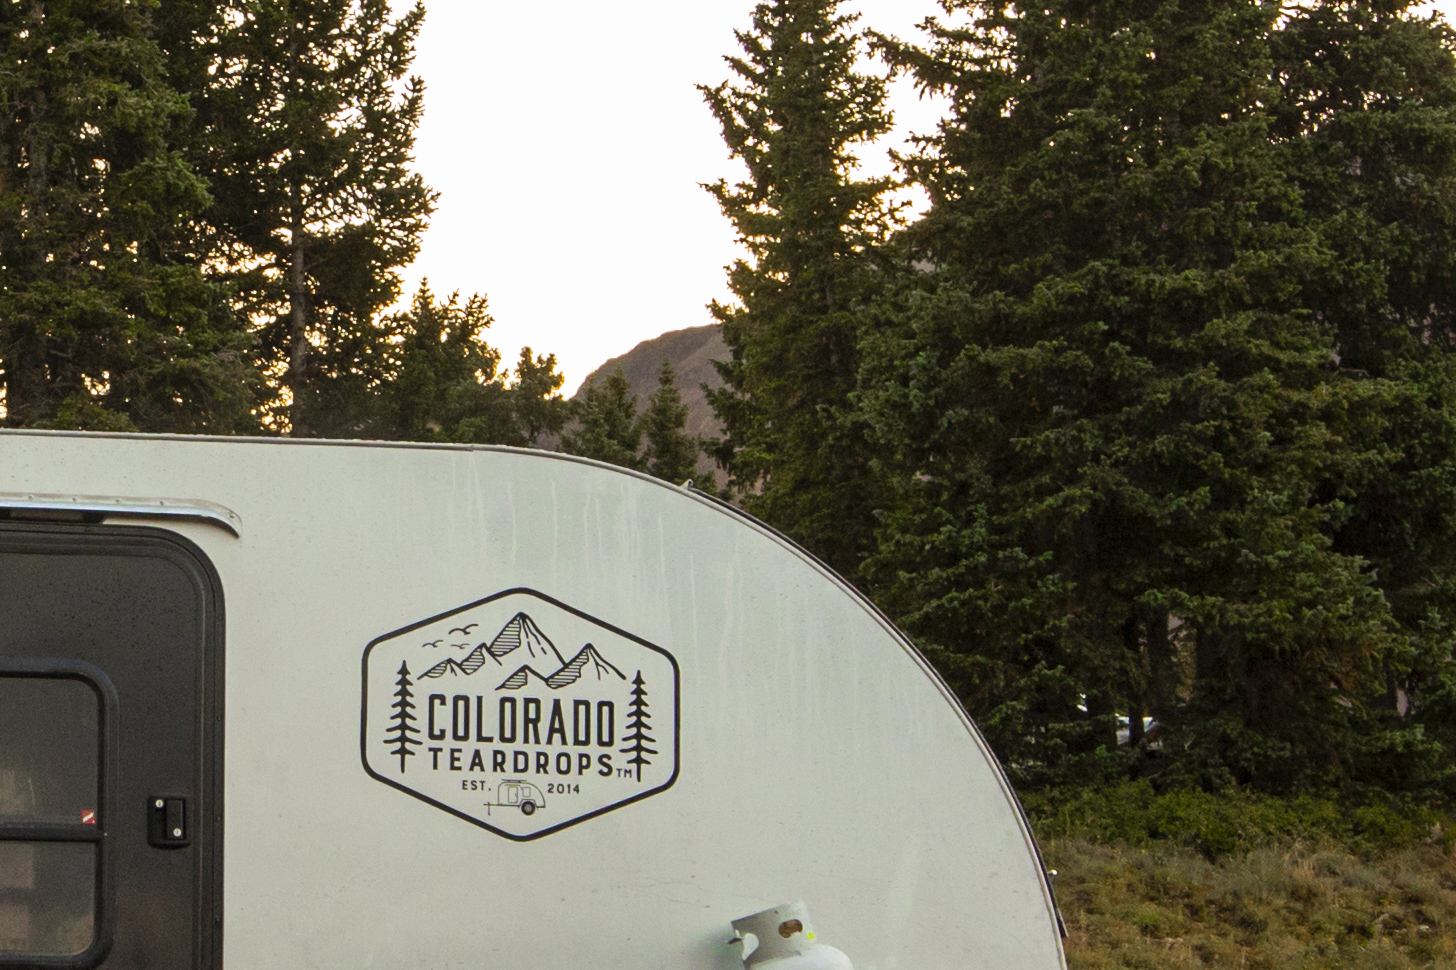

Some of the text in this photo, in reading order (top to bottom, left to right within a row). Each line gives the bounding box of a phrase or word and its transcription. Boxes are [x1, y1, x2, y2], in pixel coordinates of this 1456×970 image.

[427, 693, 615, 747] COLORADO
[427, 747, 614, 777] TEARDROPS
[461, 779, 580, 795] EST. 2014
